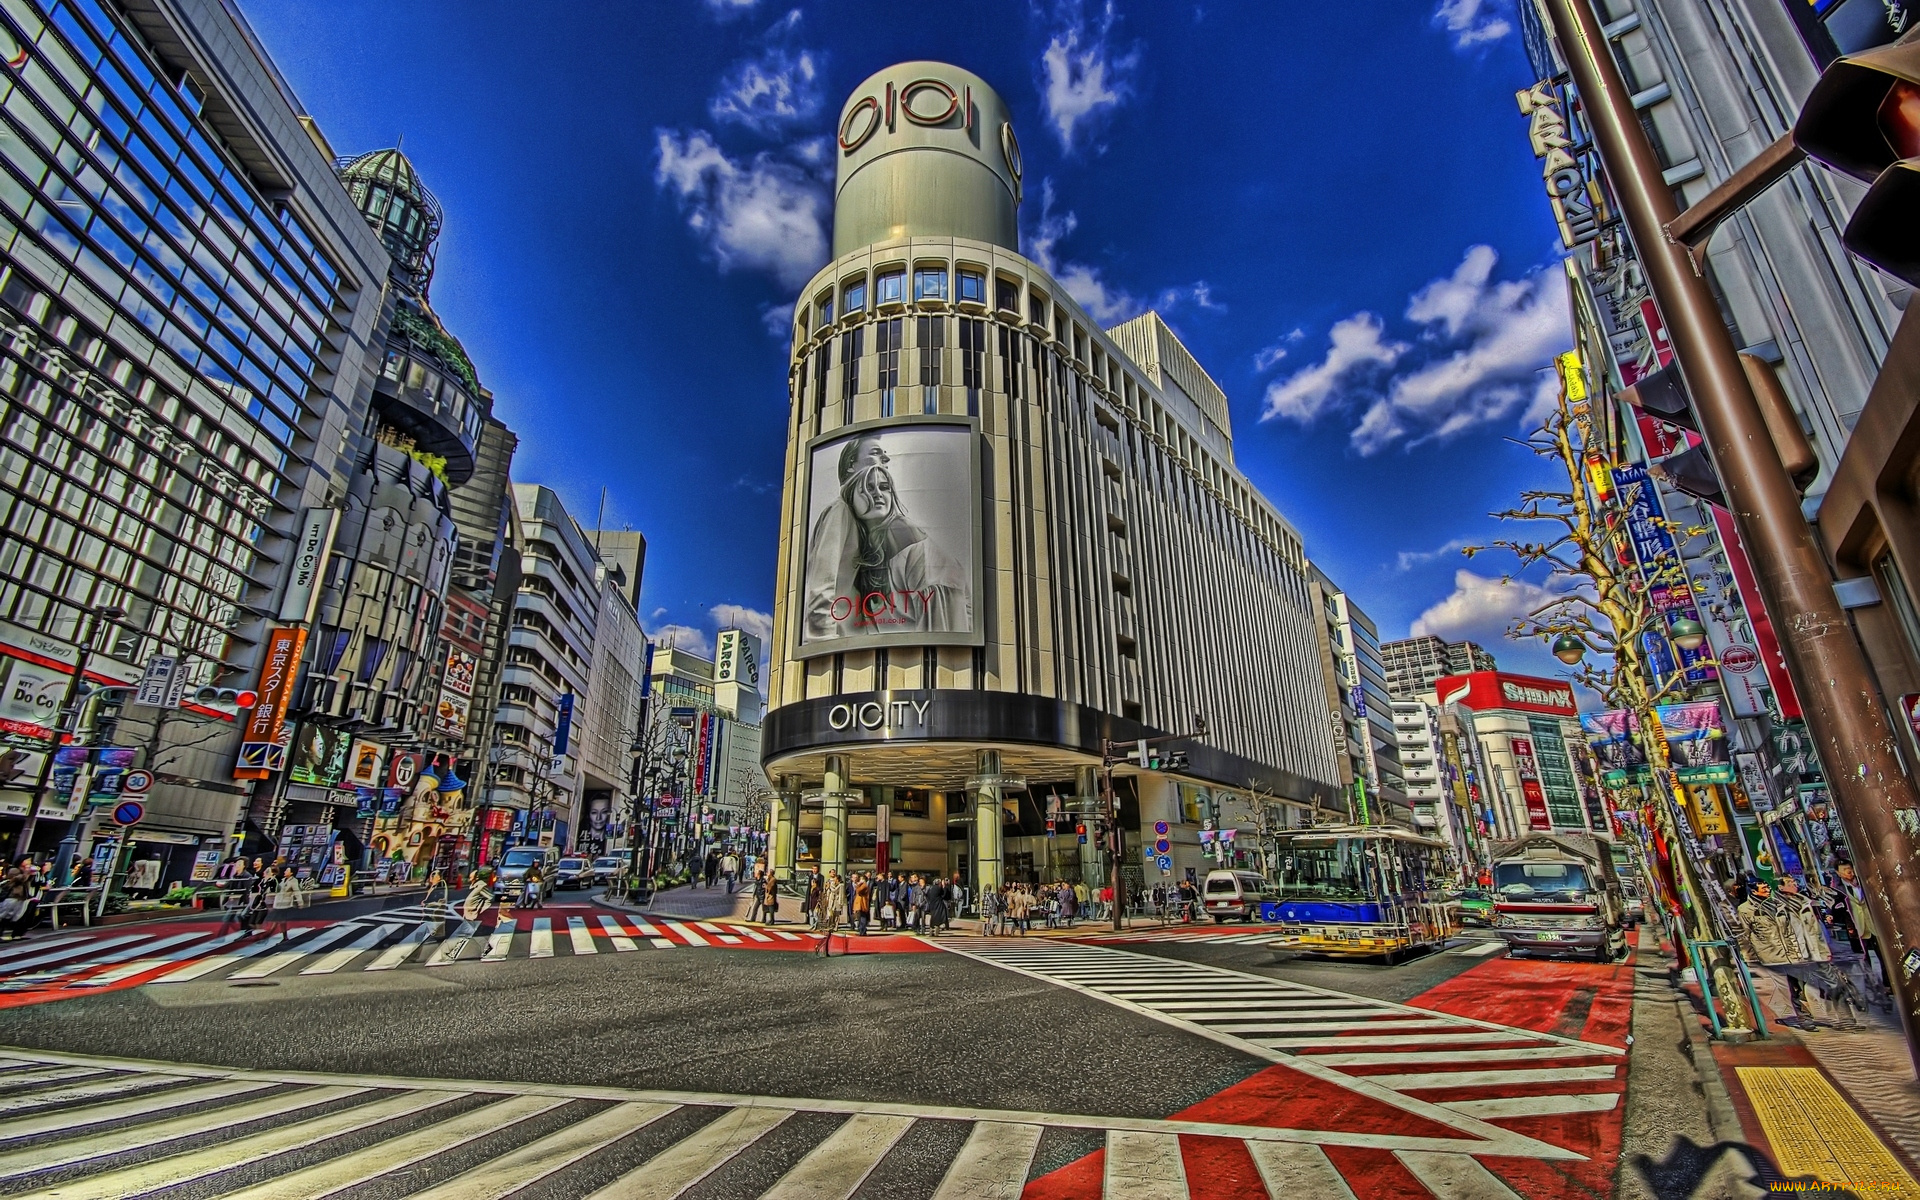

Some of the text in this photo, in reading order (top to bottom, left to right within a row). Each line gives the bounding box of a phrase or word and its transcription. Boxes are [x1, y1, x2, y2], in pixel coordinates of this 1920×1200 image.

[1515, 79, 1600, 249] KARAOKE
[719, 633, 734, 680] PARCO
[739, 635, 760, 684] PARCO
[18, 680, 33, 689] NTT
[252, 638, 292, 734] 東京スター銀行
[273, 639, 303, 734] TOKYO STAR BANK
[1502, 681, 1574, 709] SHIDAX
[828, 700, 931, 730] OICITY
[1330, 709, 1348, 757] OICITY
[128, 776, 146, 787] 30
